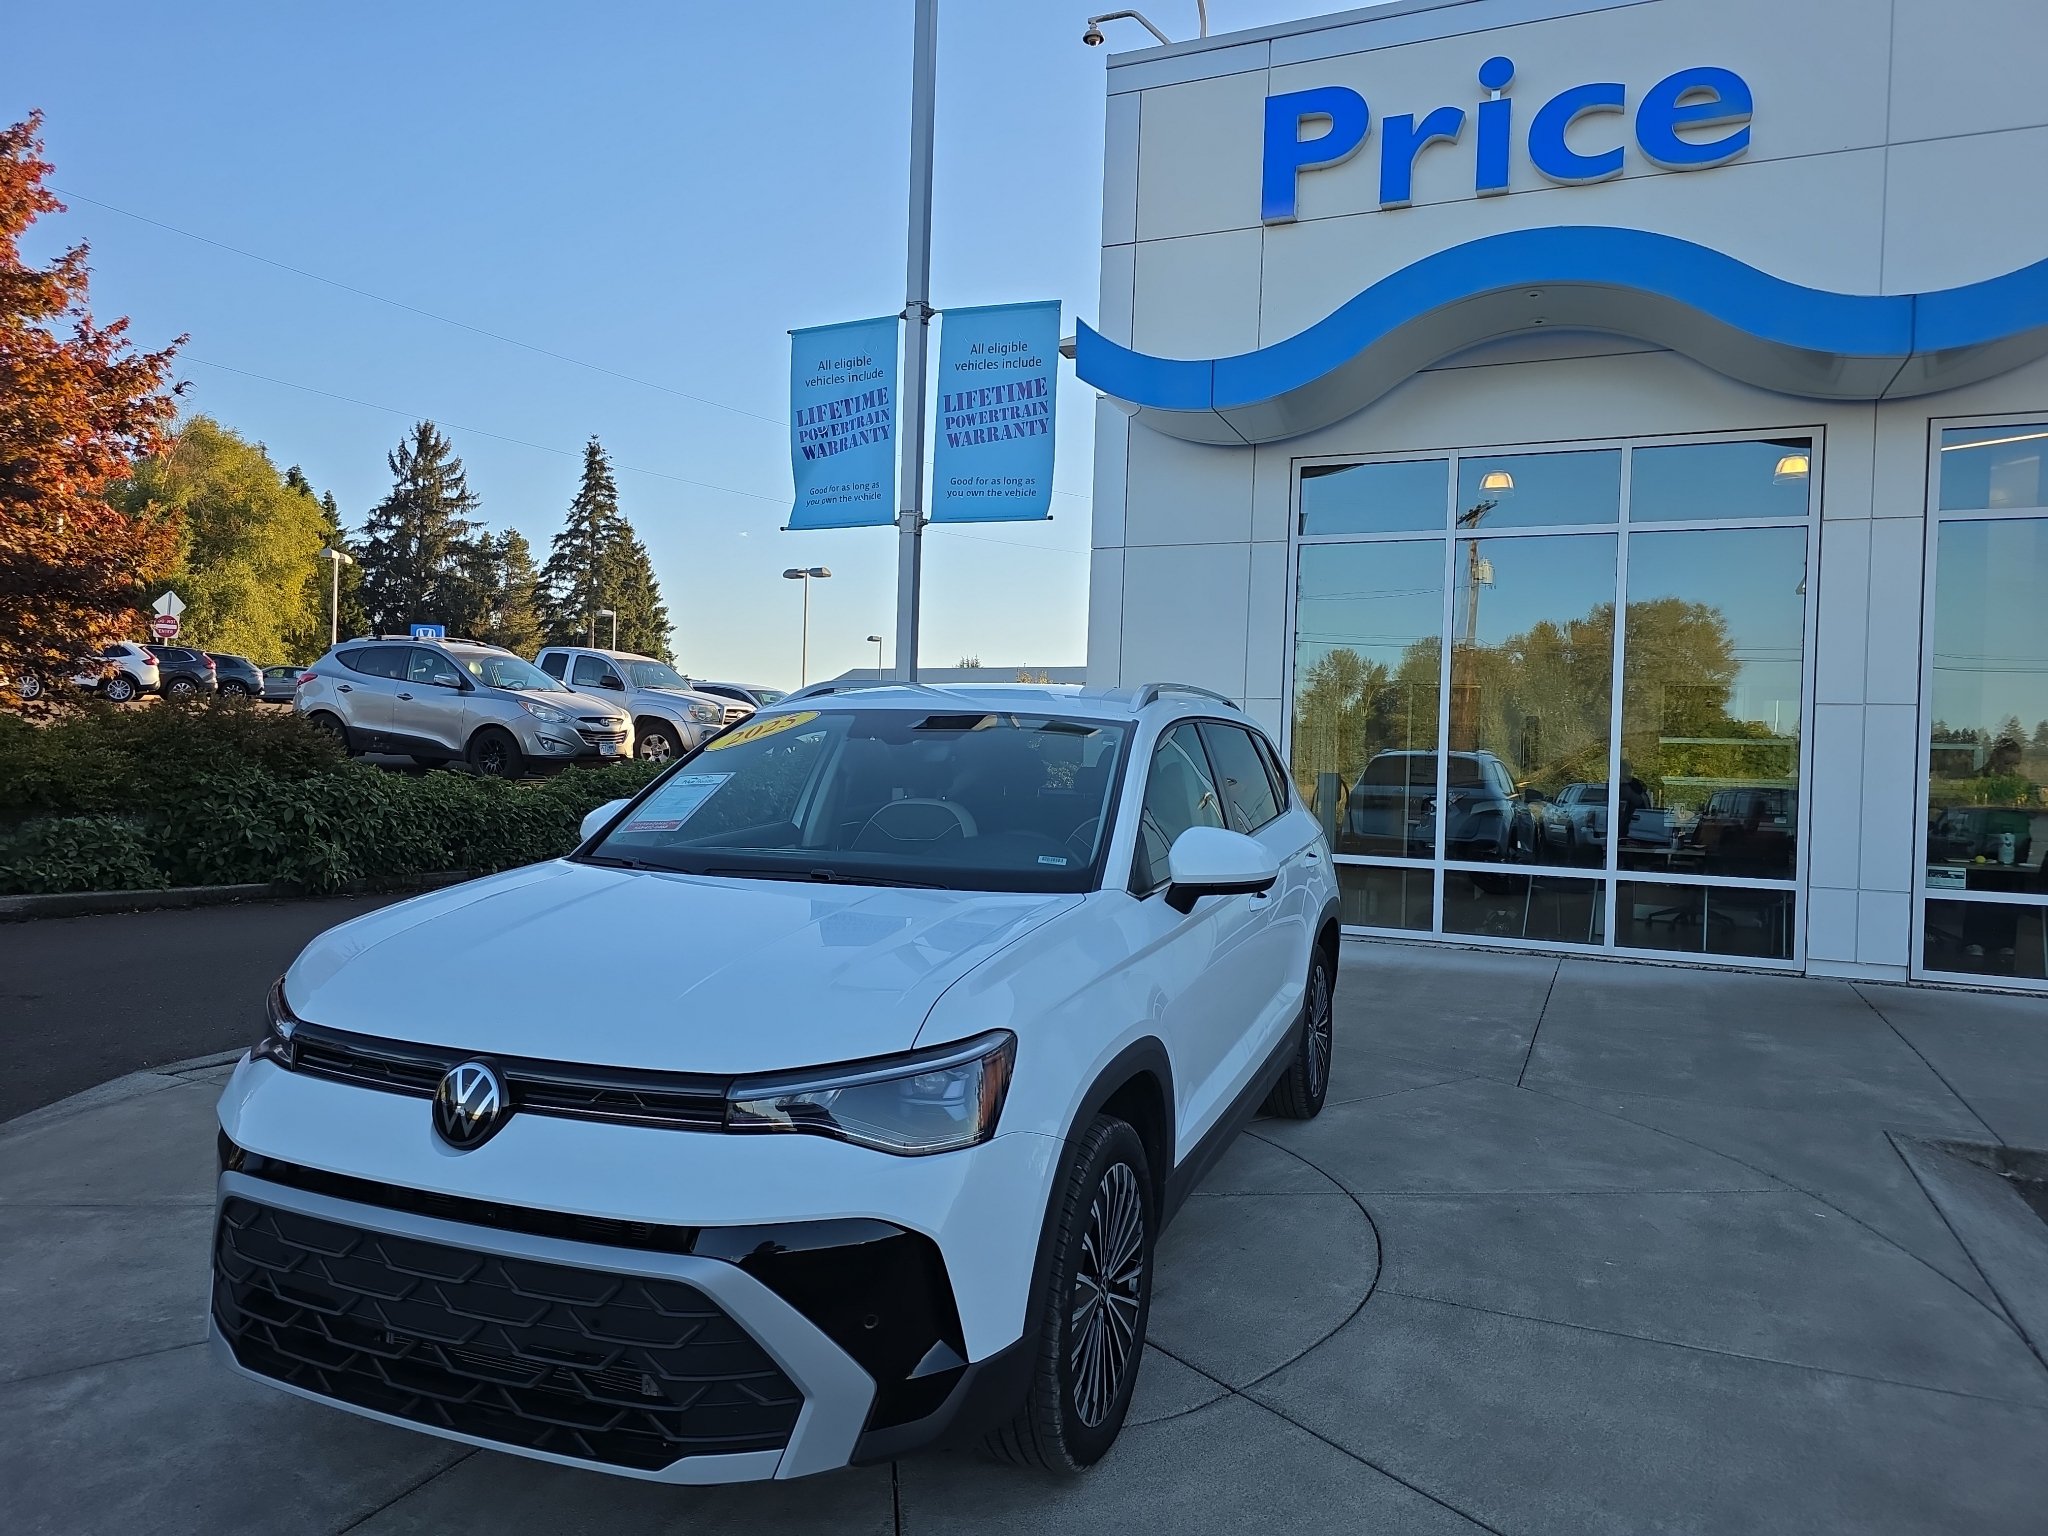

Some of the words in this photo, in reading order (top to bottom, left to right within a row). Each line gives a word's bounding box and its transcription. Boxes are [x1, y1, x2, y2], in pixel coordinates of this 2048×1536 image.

[1261, 56, 1754, 226] Price
[970, 343, 984, 355] All
[987, 340, 1028, 356] eligible
[818, 359, 831, 371] All
[834, 355, 872, 371] eligible
[955, 358, 999, 371] vehicles
[1002, 355, 1042, 369] include
[805, 373, 845, 387] vehicles
[848, 367, 884, 383] include
[796, 386, 889, 427] LIFETIME
[943, 376, 1048, 413] LIFETIME
[799, 407, 890, 443] POWERTRAIN
[945, 399, 1049, 431] POWERTRAIN
[801, 423, 891, 461] WARRANTY
[946, 417, 1050, 449] WARRANTY
[809, 485, 828, 496] Good
[828, 484, 840, 493] for
[841, 484, 851, 492] as
[852, 482, 870, 491] long
[871, 481, 880, 489] as
[946, 490, 964, 499] you
[987, 488, 1002, 497] the
[1004, 488, 1037, 497] vehicle
[950, 476, 974, 486] Good
[975, 476, 988, 485] for
[1003, 476, 1023, 487] long
[805, 499, 820, 508] you
[821, 496, 838, 505] own
[839, 494, 853, 503] the
[853, 491, 882, 501] vehicle
[723, 713, 801, 746] 2025
